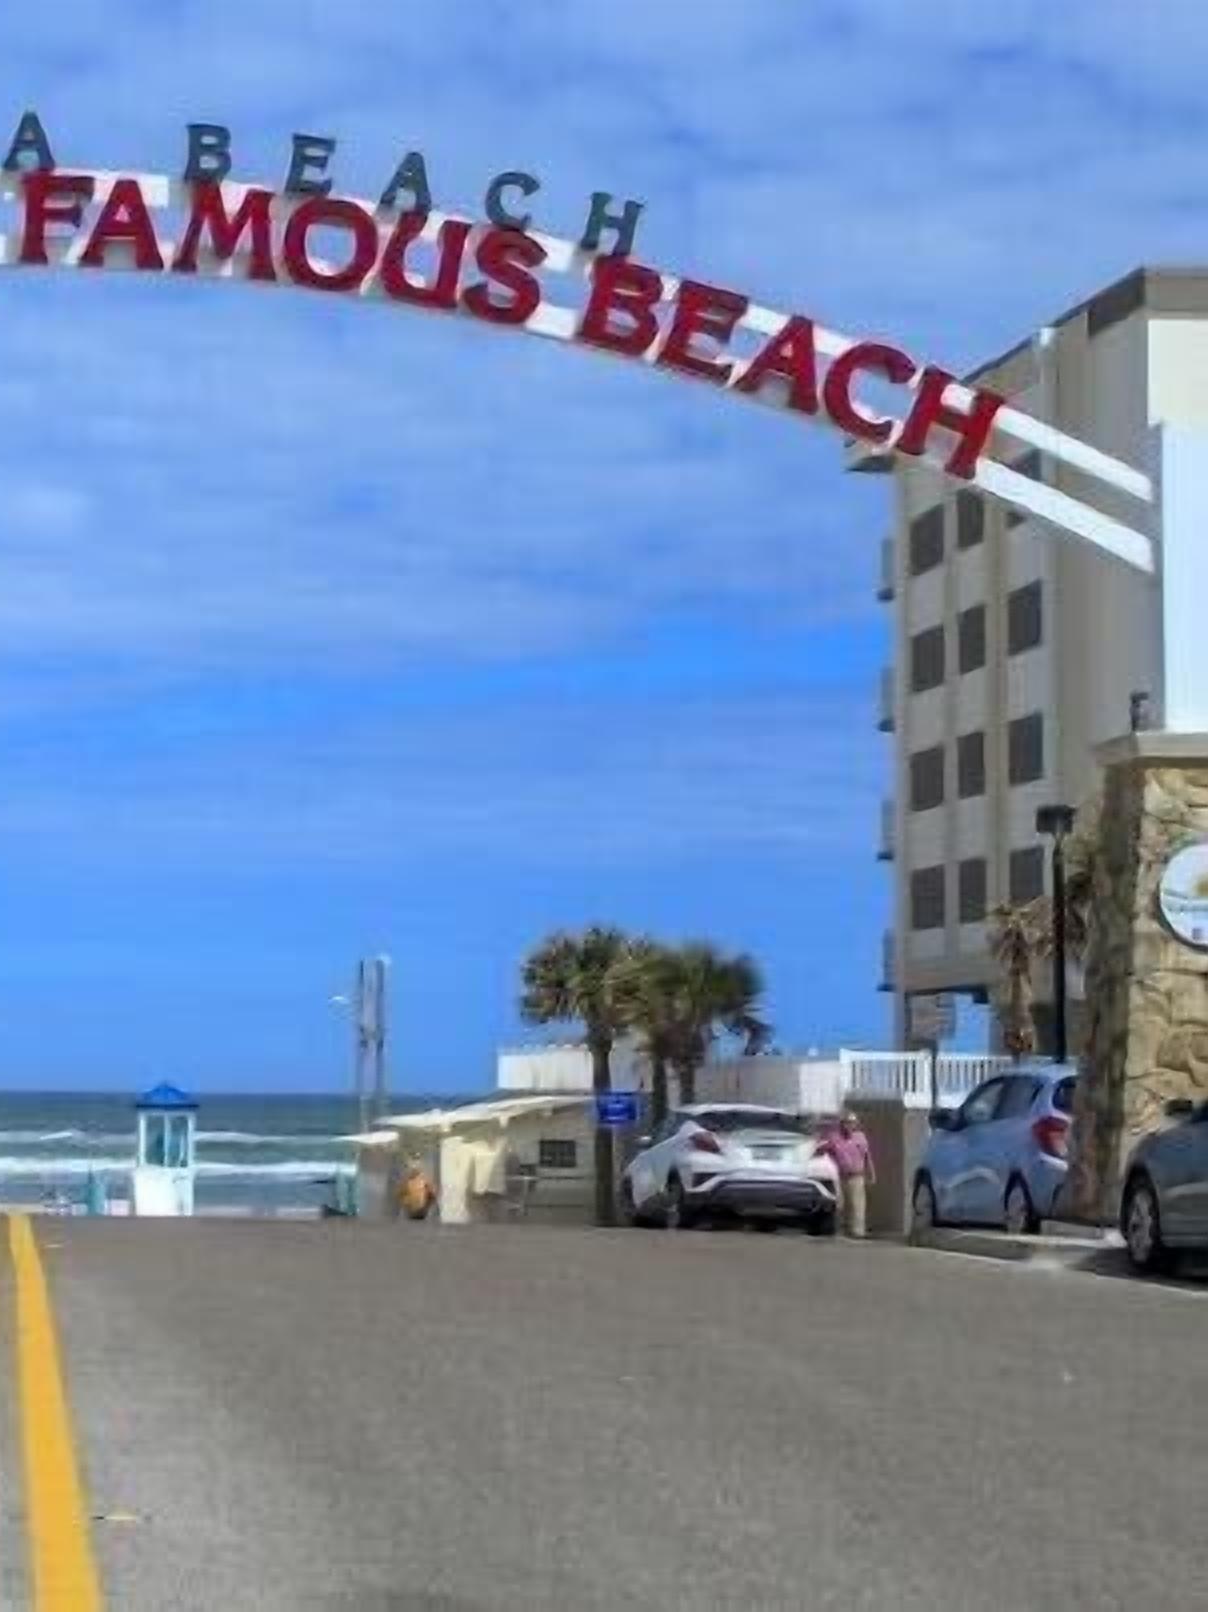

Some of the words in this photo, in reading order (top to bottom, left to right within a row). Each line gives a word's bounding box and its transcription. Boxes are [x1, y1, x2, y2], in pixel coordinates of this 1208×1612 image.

[183, 123, 645, 256] BEACH
[21, 174, 549, 324] FAMOUS
[574, 252, 1007, 480] BEACH
